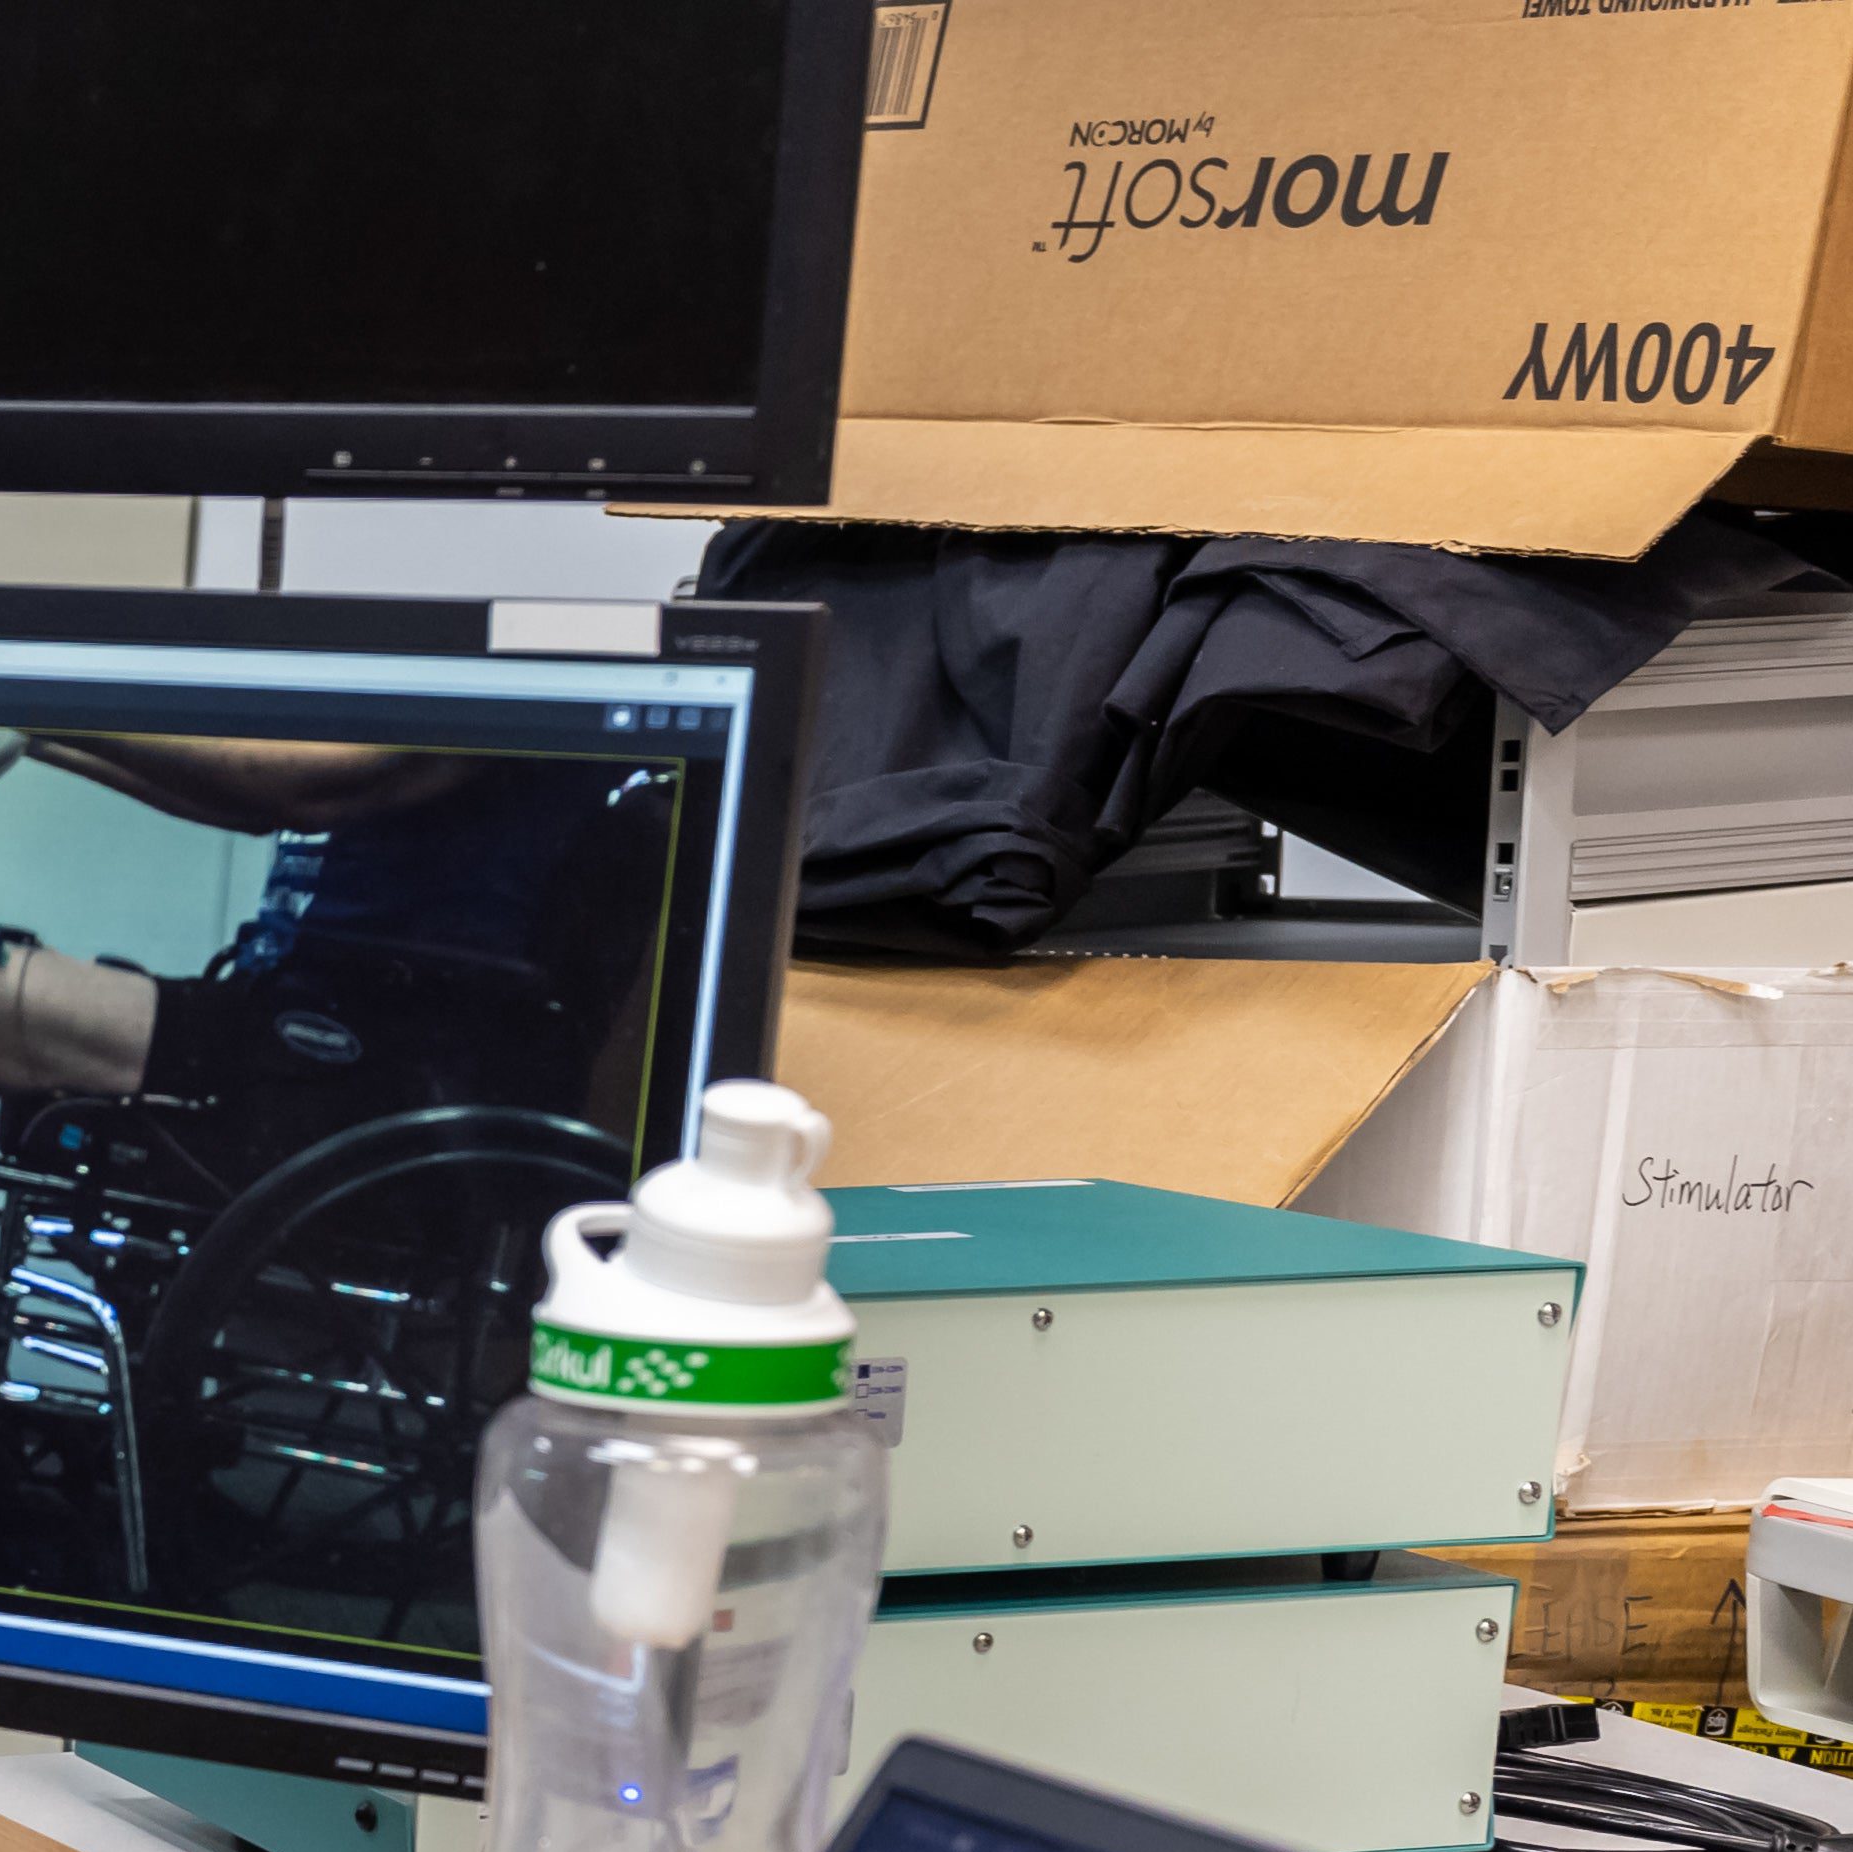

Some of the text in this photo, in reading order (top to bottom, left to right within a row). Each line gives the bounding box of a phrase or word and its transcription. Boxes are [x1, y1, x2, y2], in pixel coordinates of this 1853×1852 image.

[1053, 151, 1449, 264] morsoft
[1502, 321, 1778, 405] 400WY
[1621, 1154, 1815, 1214] Stimulator
